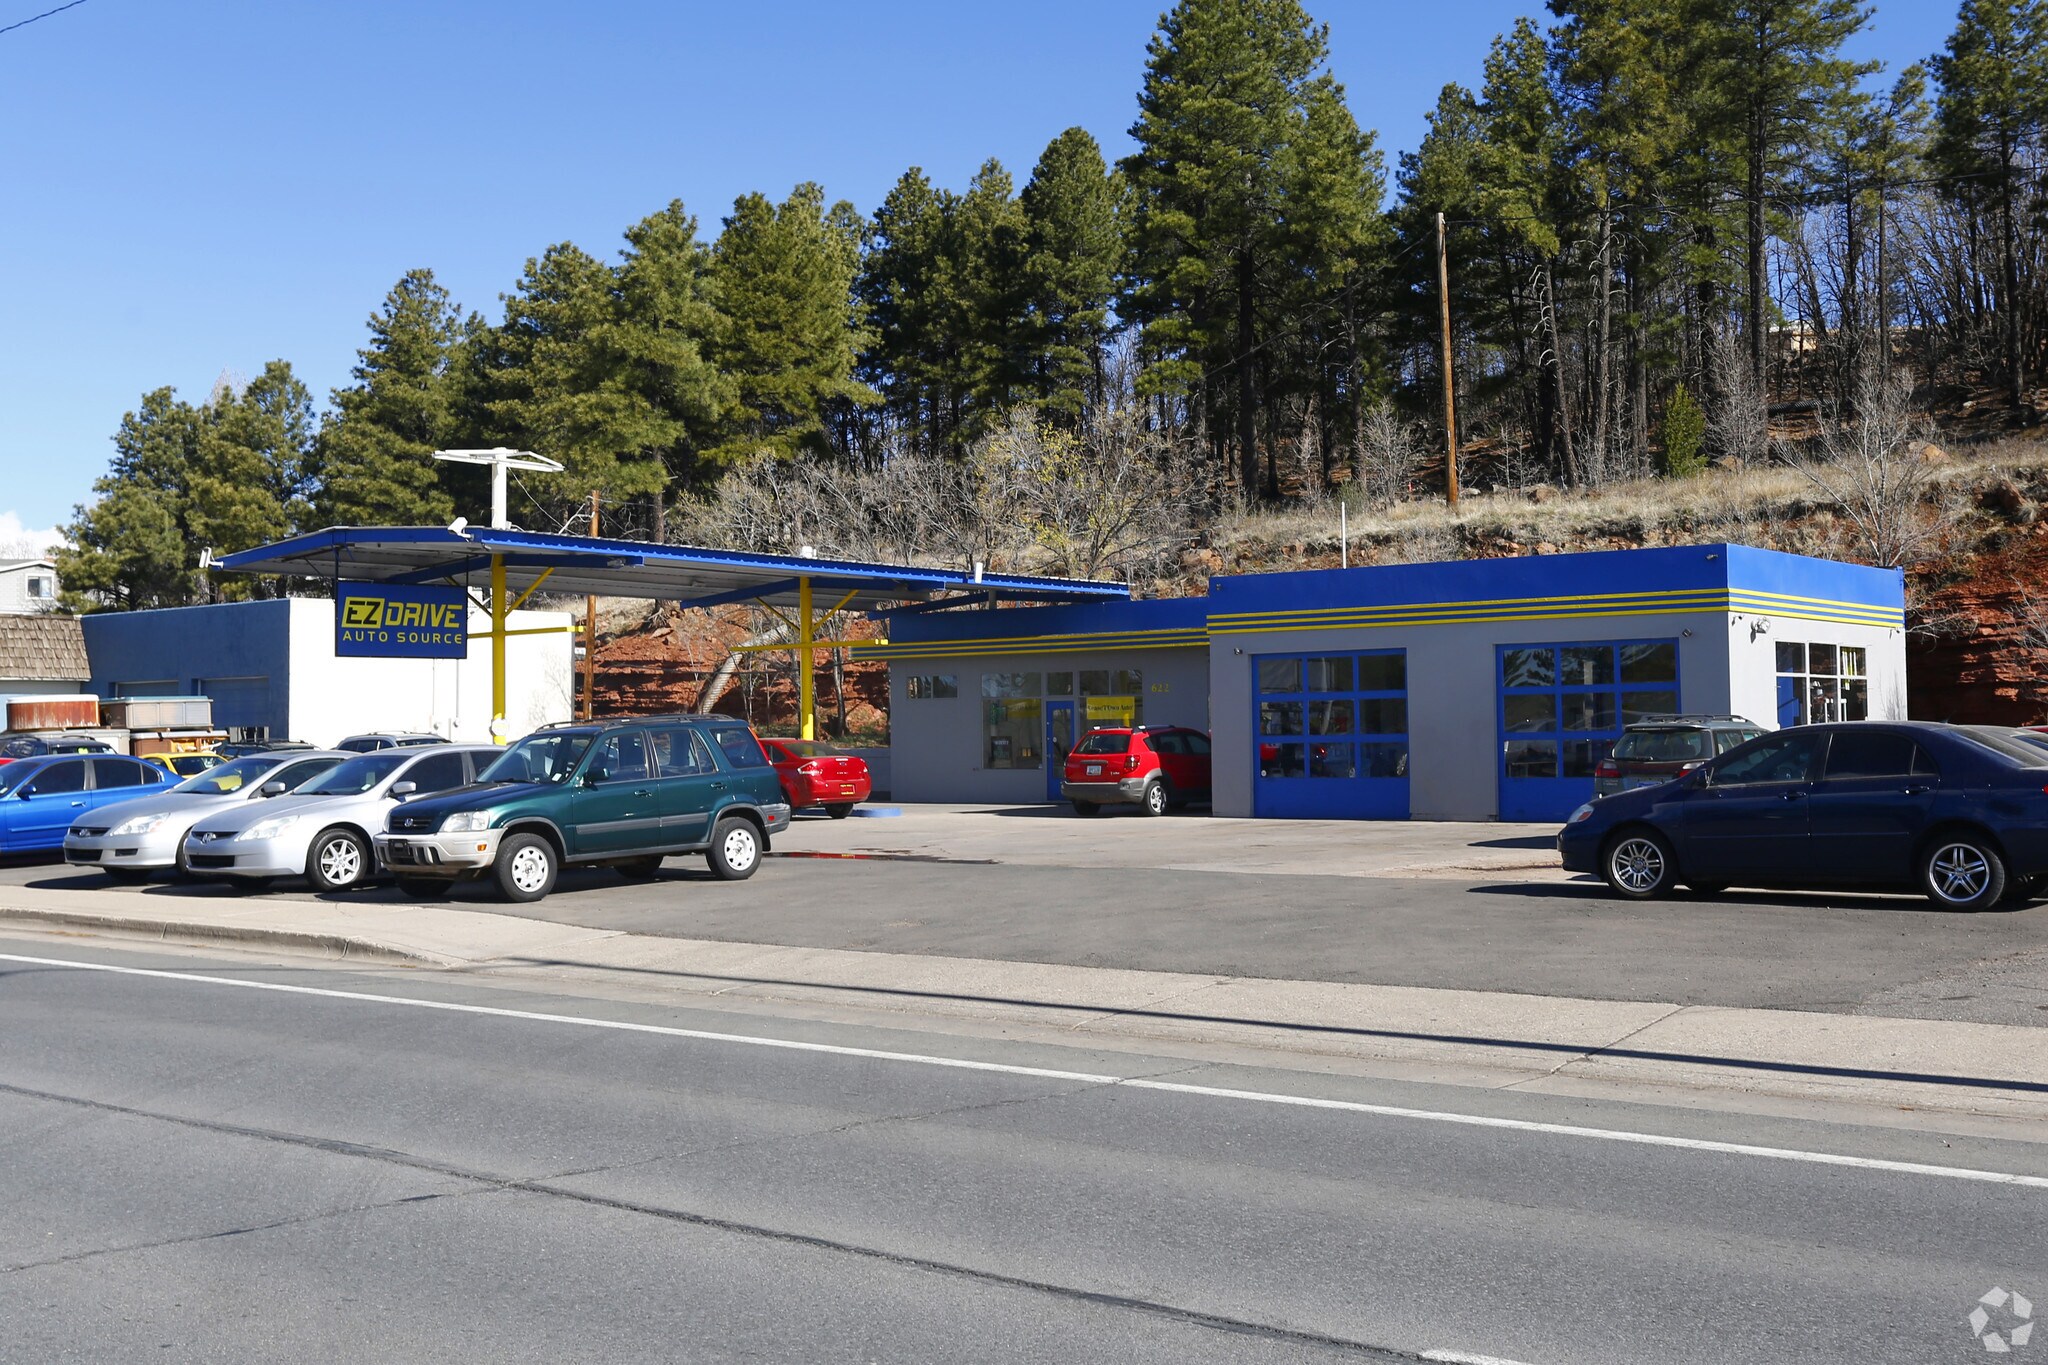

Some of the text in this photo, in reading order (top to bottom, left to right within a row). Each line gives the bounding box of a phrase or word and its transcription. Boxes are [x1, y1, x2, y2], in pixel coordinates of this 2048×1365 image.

[346, 601, 462, 628] EZ DRIVE
[342, 630, 462, 644] AUTO SOURCE
[1151, 683, 1169, 692] 622
